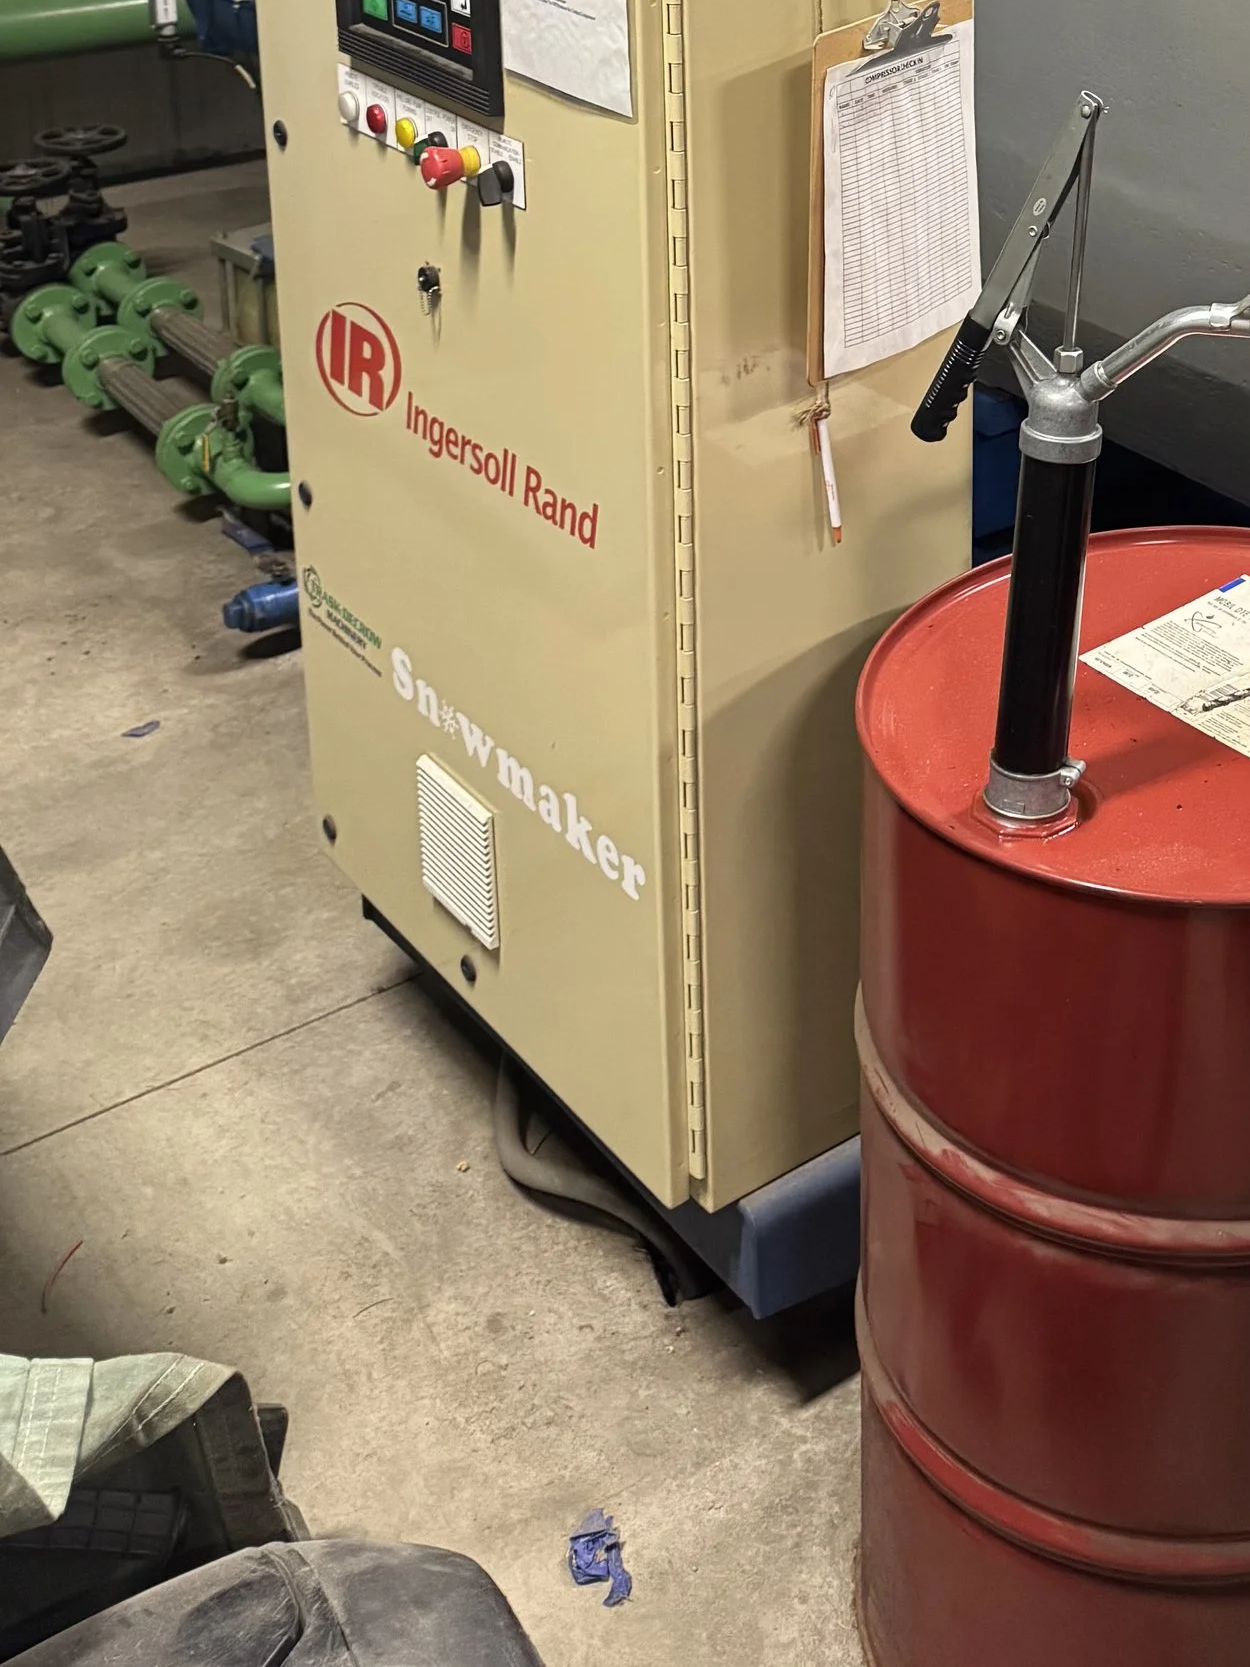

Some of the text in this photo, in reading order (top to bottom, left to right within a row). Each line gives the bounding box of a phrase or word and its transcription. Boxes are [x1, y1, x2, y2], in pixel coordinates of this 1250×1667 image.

[328, 307, 600, 550] IR Ingersoll Rand
